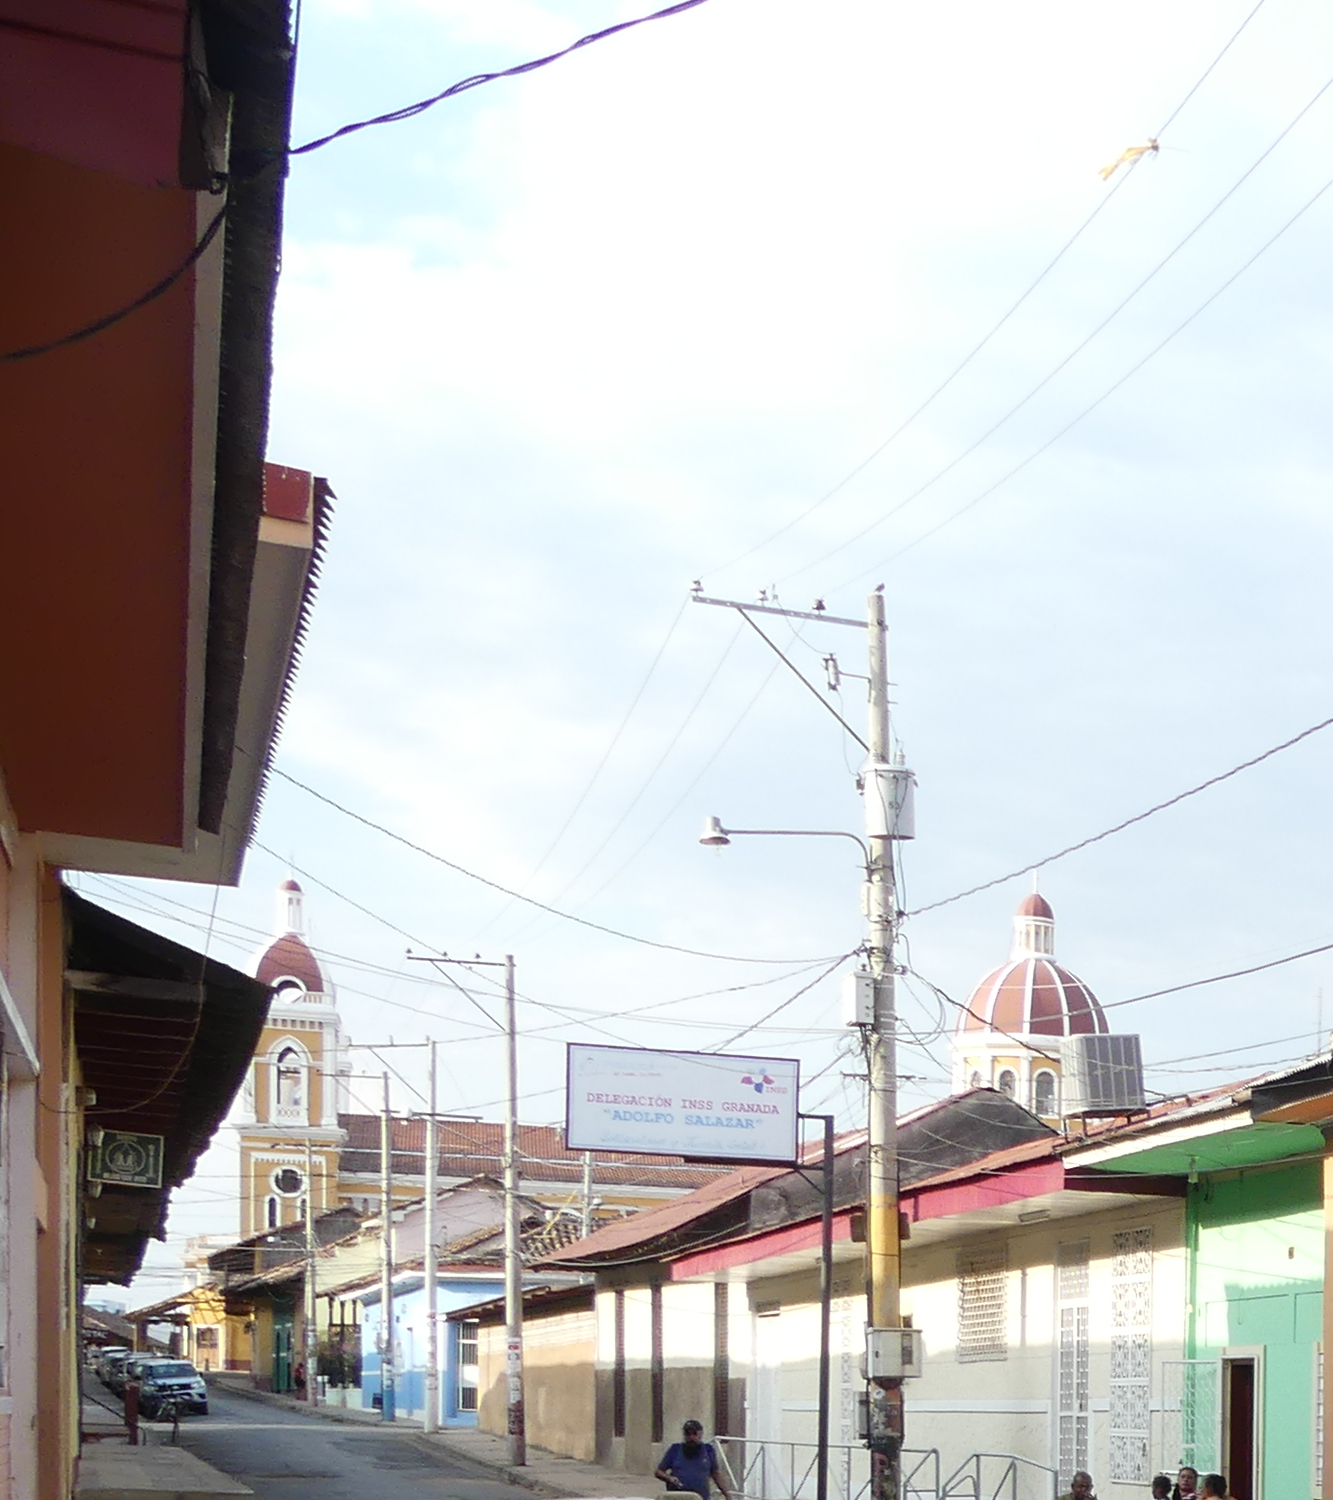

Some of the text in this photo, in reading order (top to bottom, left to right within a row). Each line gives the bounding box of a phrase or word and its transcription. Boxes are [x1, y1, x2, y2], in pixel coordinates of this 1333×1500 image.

[586, 1092, 780, 1115] DELEGACIÓN INSS GRANADA
